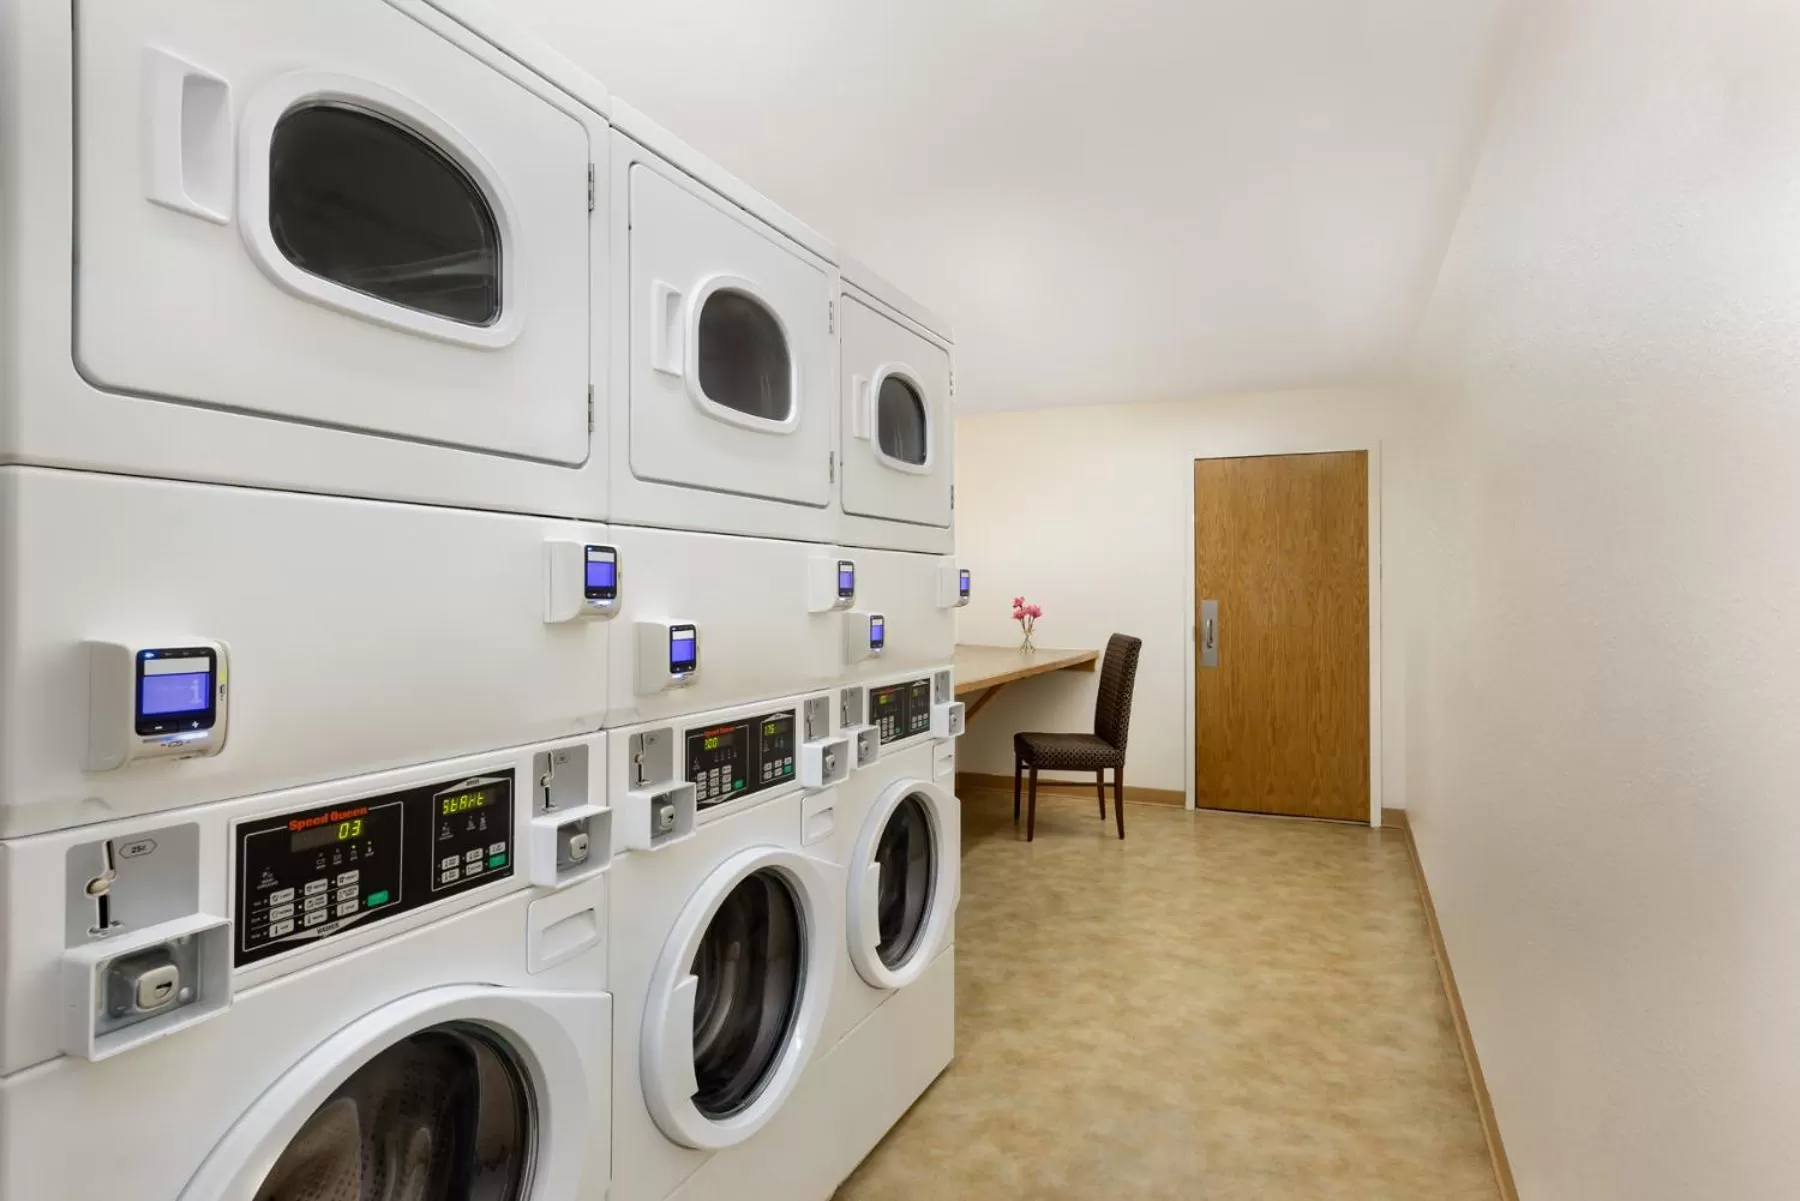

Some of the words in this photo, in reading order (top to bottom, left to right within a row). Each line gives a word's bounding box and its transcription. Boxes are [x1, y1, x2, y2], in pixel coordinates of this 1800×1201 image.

[288, 813, 329, 832] Speed
[330, 806, 368, 821] Queen
[338, 819, 361, 840] 03
